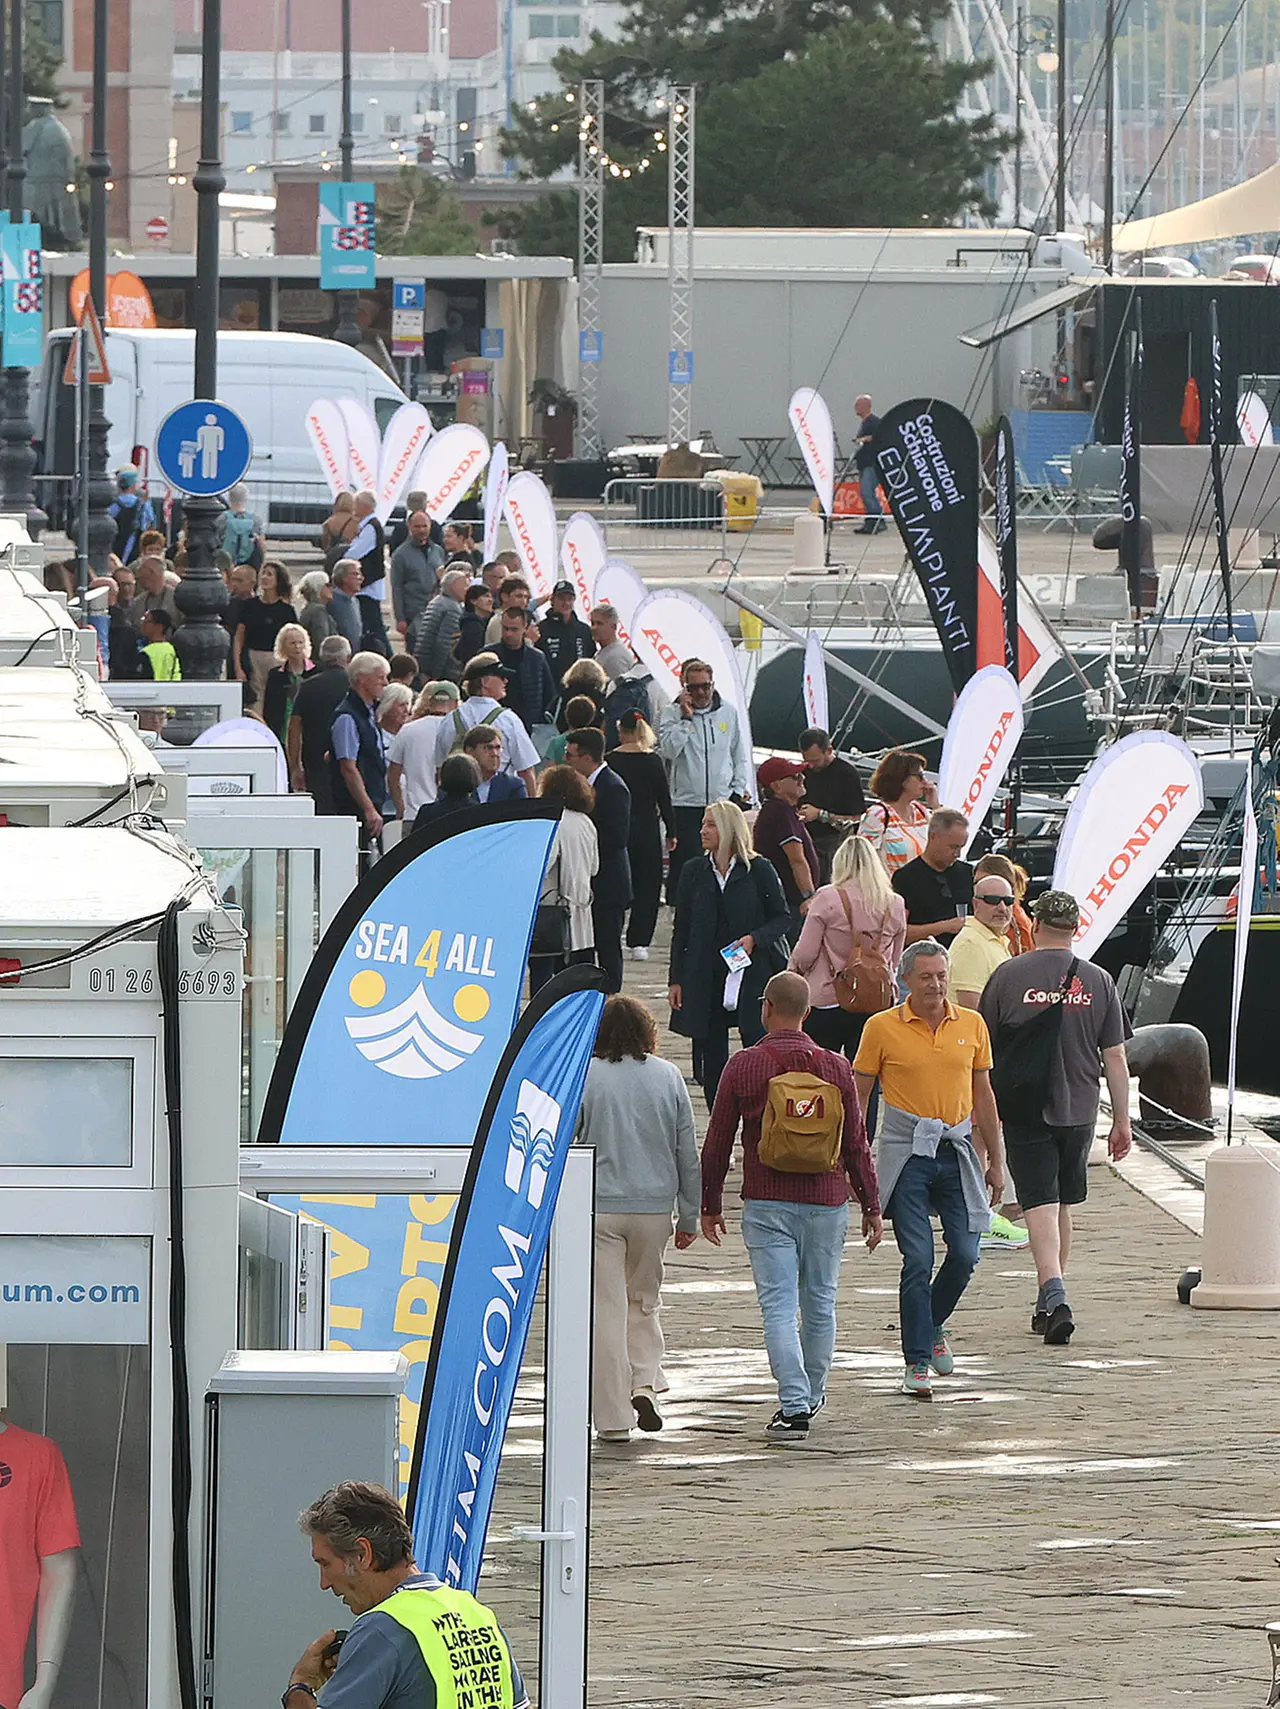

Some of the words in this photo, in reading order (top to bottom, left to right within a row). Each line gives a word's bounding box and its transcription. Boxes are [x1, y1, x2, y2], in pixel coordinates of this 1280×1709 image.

[402, 287, 416, 304] P
[390, 425, 425, 485] HONDA
[427, 448, 482, 512] HONDA
[898, 420, 944, 512] Schiavone
[916, 413, 966, 506] Costruzioni
[877, 447, 970, 652] EDILIMPIANTI
[1085, 783, 1190, 910] HONDA
[355, 919, 410, 965] SEA
[414, 929, 443, 978] 4
[445, 932, 496, 978] ALL
[89, 968, 115, 992] 01
[2, 1284, 140, 1303] um.com
[442, 1626, 498, 1651] LAREST
